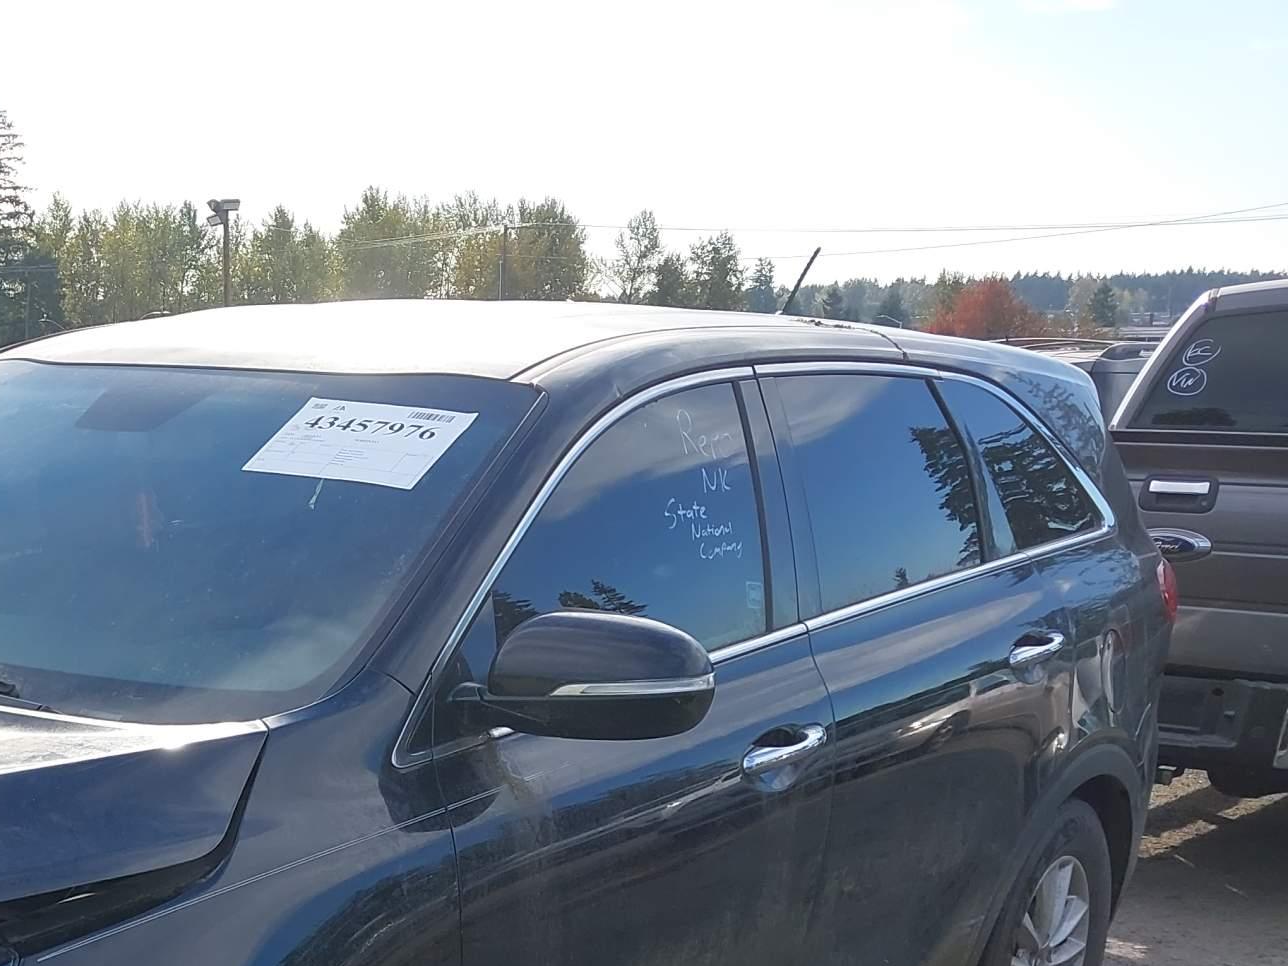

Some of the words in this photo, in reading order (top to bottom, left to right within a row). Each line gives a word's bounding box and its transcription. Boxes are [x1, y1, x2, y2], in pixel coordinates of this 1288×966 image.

[304, 415, 441, 441] 43457976
[664, 497, 708, 530] State
[691, 521, 733, 541] National
